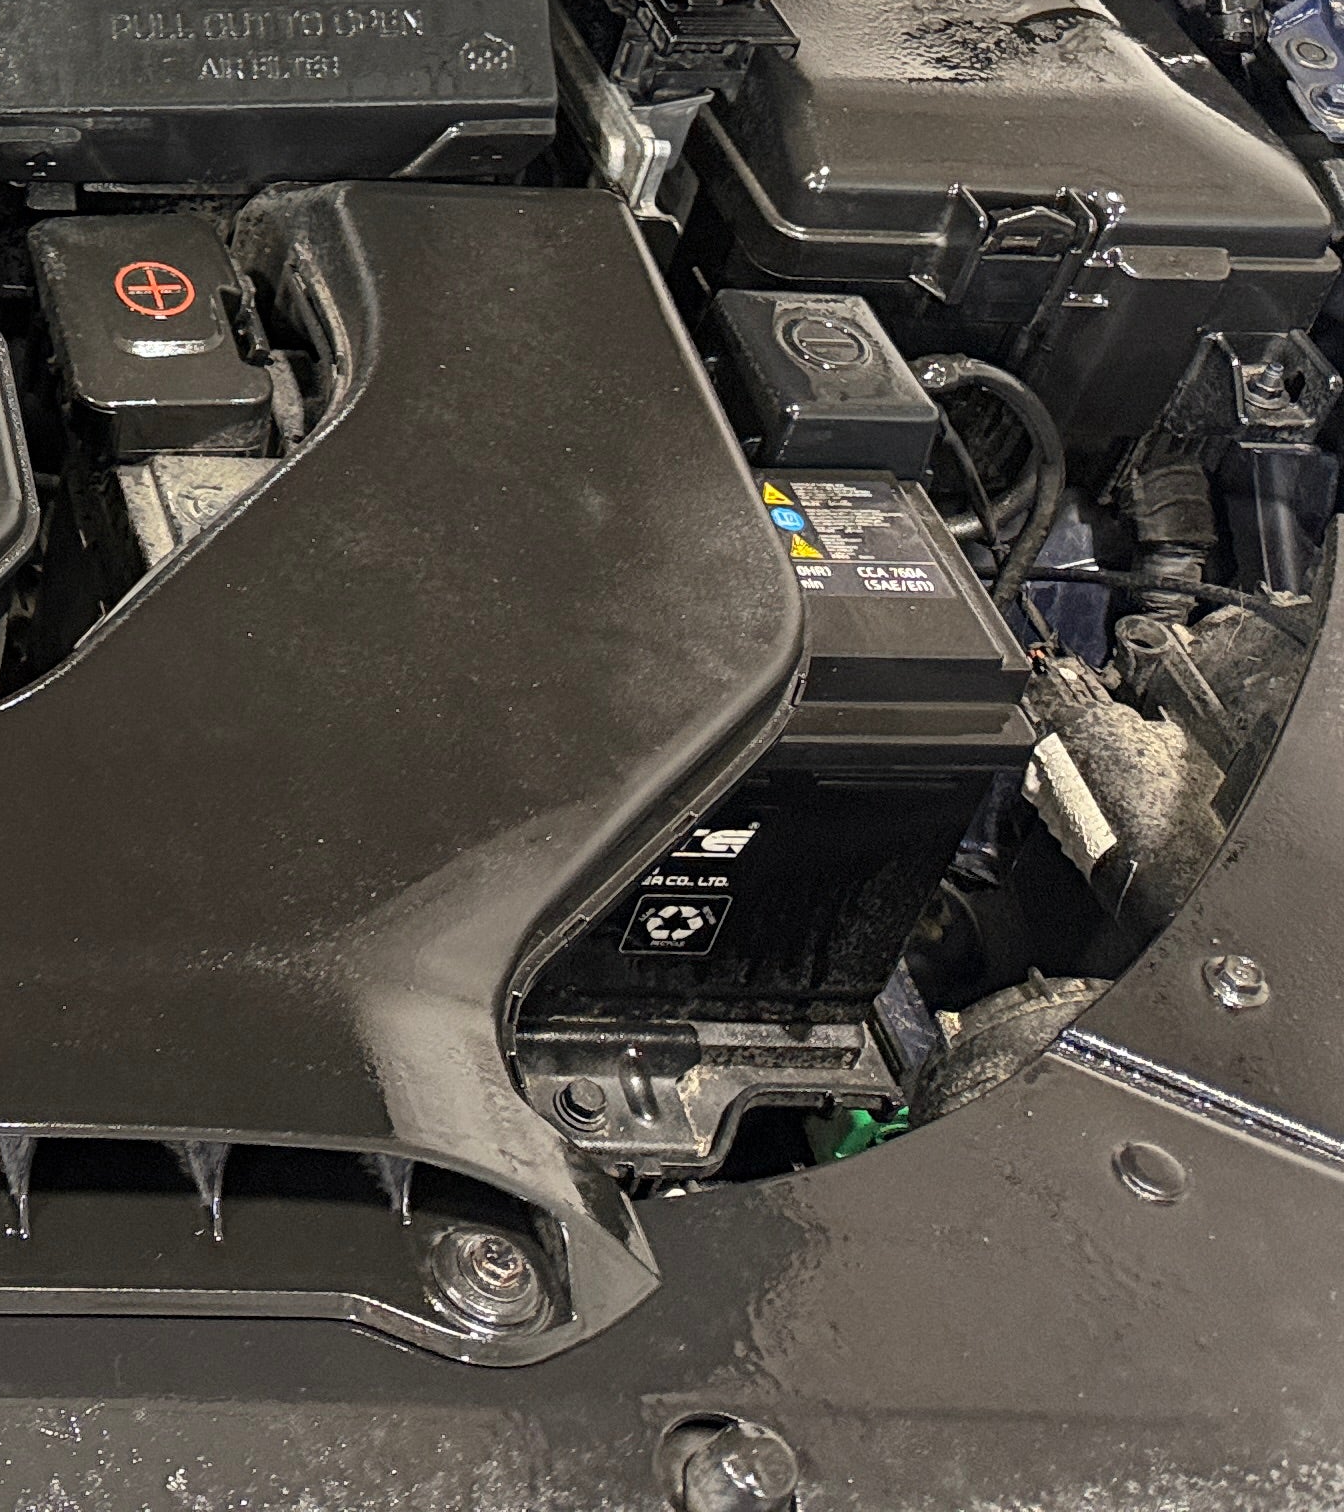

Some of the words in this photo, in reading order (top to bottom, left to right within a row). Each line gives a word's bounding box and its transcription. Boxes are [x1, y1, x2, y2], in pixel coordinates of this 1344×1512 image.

[111, 13, 196, 41] PULL
[204, 10, 274, 41] OUT
[280, 9, 324, 38] TO
[333, 8, 425, 37] OPEN
[856, 566, 890, 578] CCA
